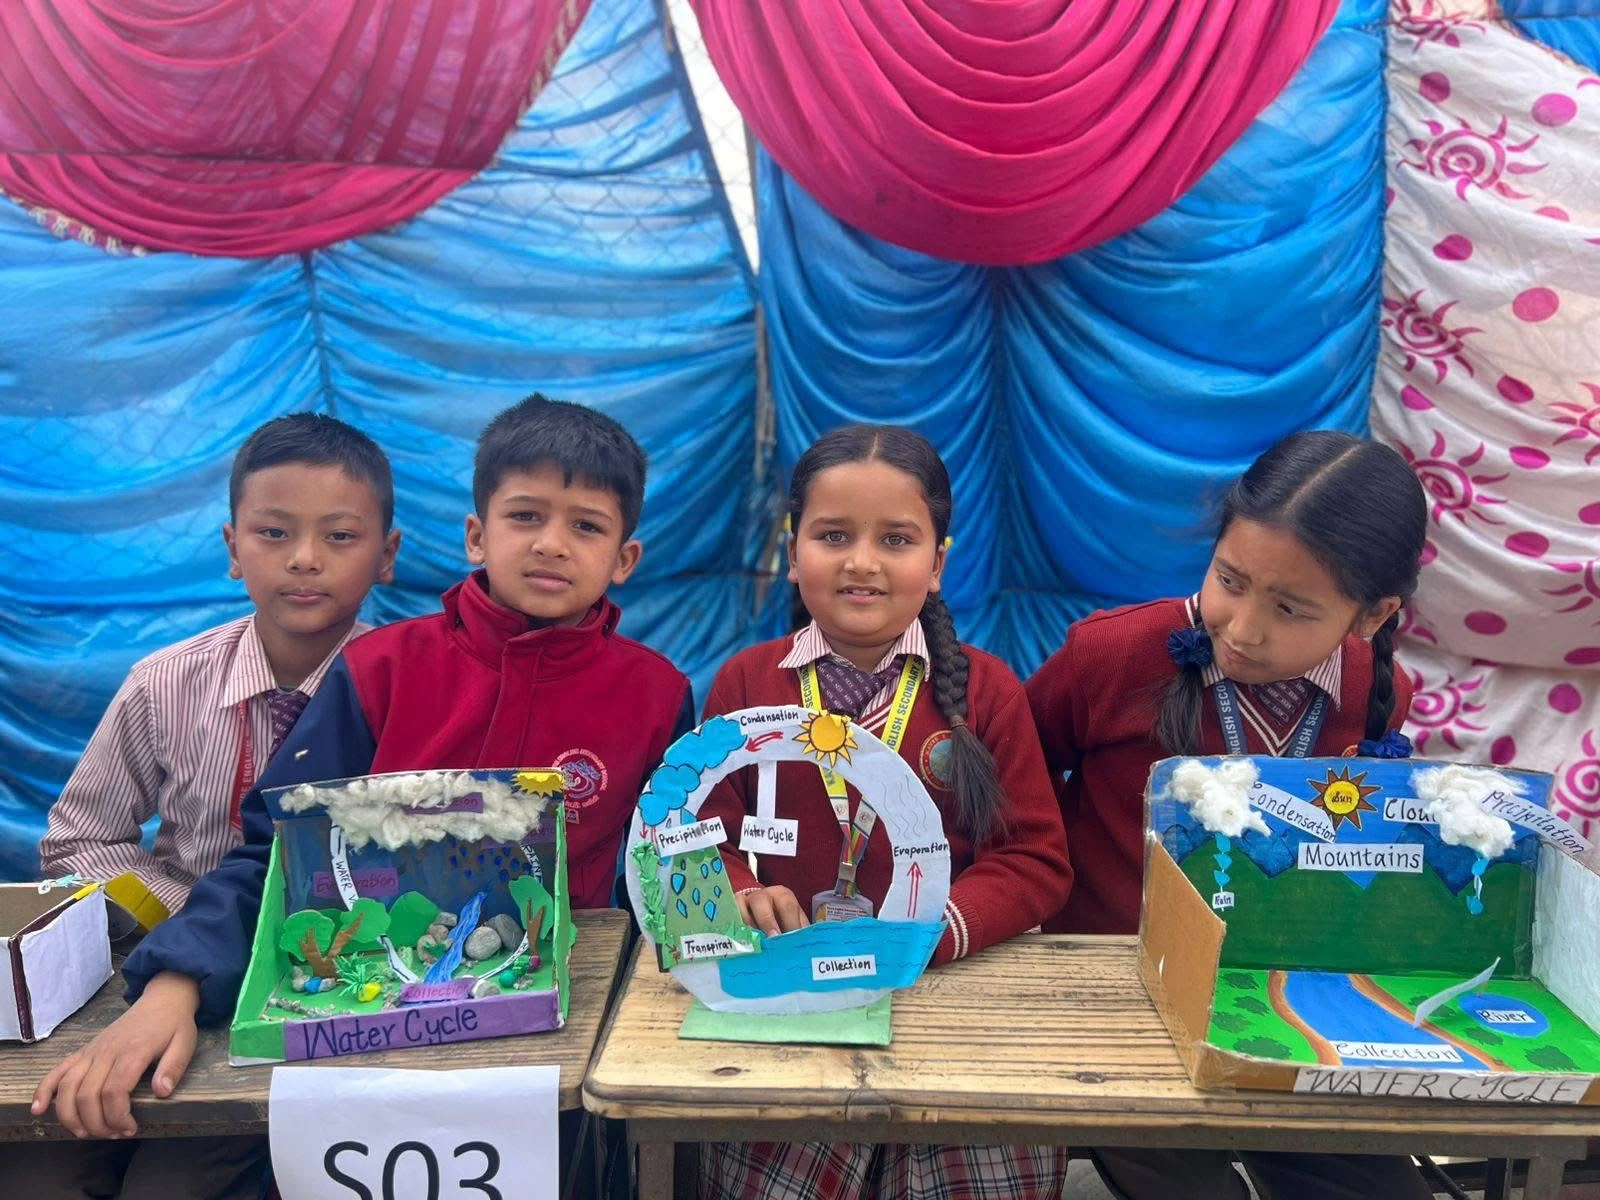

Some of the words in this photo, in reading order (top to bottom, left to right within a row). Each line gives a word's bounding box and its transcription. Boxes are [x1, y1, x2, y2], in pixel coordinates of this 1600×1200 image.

[897, 664, 920, 716] SECONDARY
[740, 709, 799, 726] Condensation
[1294, 728, 1313, 757] GLISH
[1306, 694, 1325, 726] SECON
[1224, 716, 1241, 756] NGLISH
[1332, 791, 1352, 804] Sun
[658, 822, 722, 849] Precipitation
[743, 822, 765, 838] Water
[767, 826, 794, 844] Cycle
[894, 842, 948, 859] Evaporation
[1305, 844, 1421, 869] Mountains
[335, 860, 353, 892] WATER
[685, 939, 733, 955] Transpirat
[818, 958, 871, 974] Collection
[1479, 1010, 1526, 1021] River
[303, 1019, 396, 1059] Water
[405, 1006, 478, 1045] Cycle
[1336, 1043, 1460, 1060] Collection
[1306, 1069, 1439, 1098] WATER
[1449, 1074, 1588, 1104] CYCLE
[324, 1141, 503, 1200] S03
